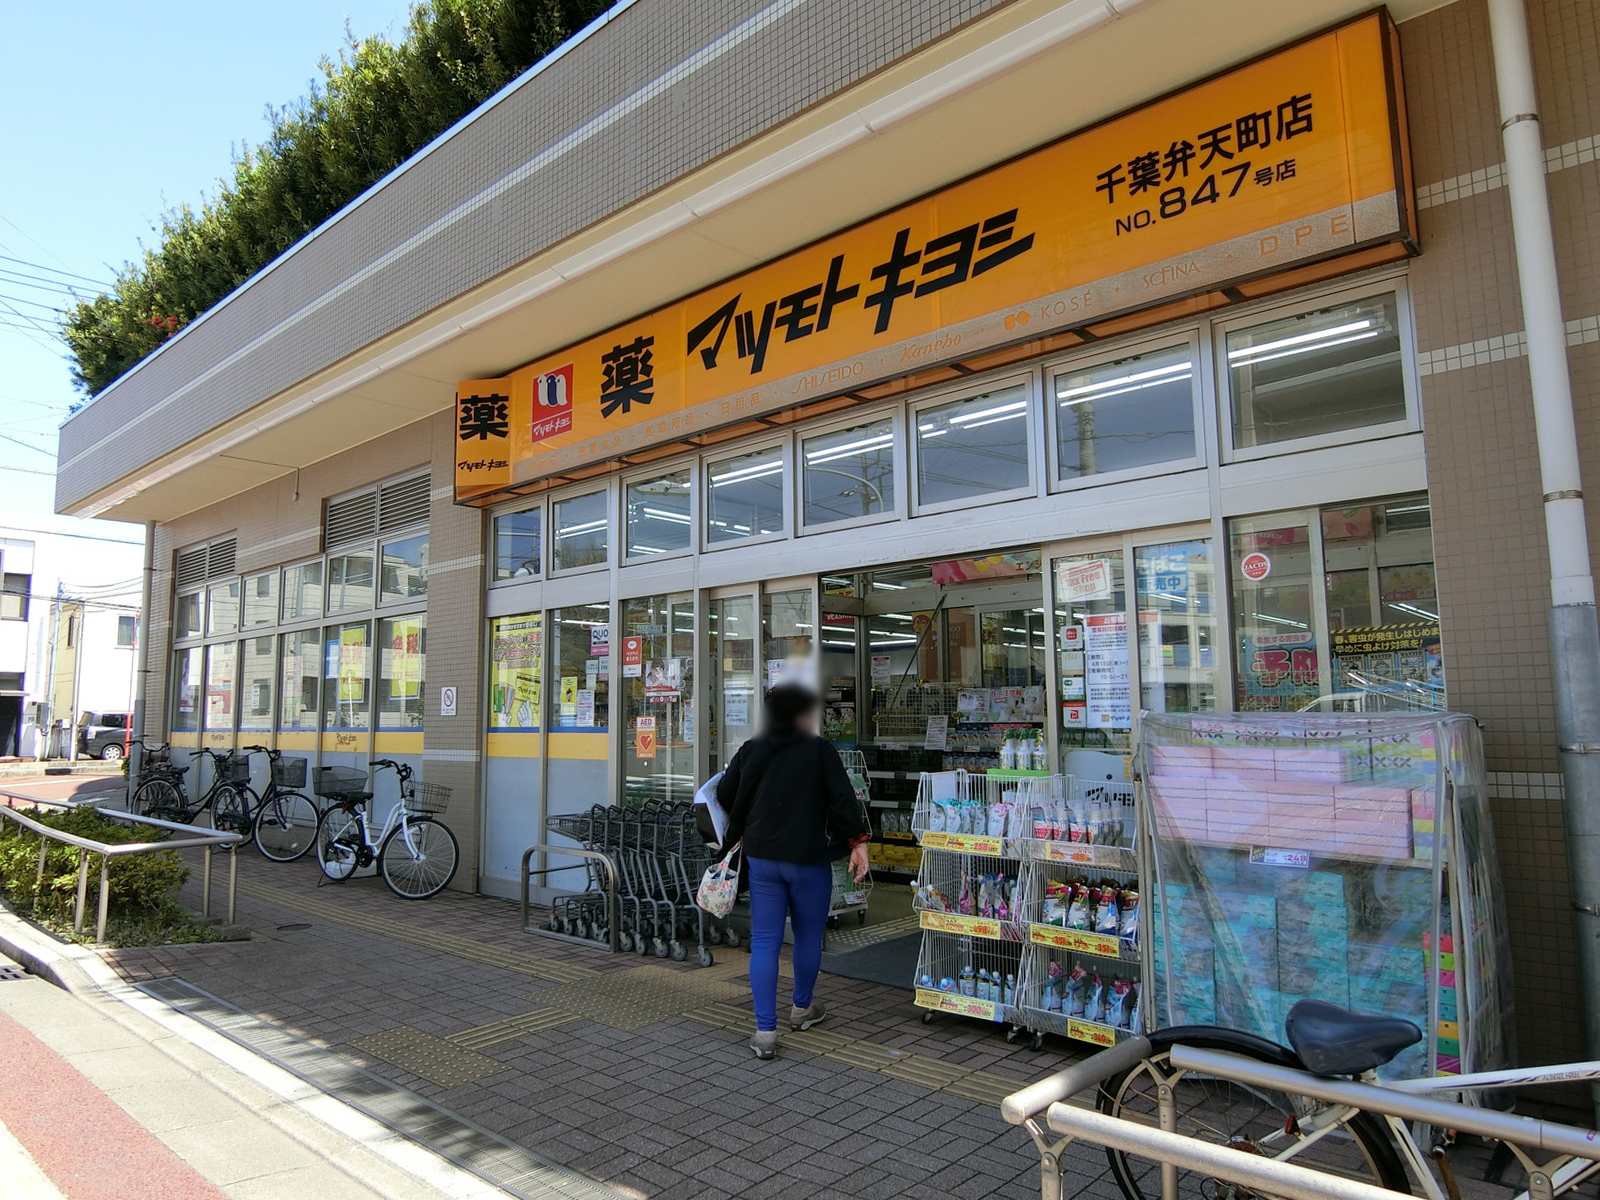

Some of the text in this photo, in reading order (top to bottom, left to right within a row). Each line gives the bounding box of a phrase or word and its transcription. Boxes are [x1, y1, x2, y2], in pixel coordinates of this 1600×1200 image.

[1095, 93, 1313, 203] 千葉弁天町店
[686, 207, 1036, 375] マツモトキヨシ
[791, 361, 864, 394] SHISEIDO
[900, 332, 962, 361] Kanebo
[1142, 261, 1200, 288] SOFINA
[601, 337, 654, 418] 薬
[459, 393, 510, 441] 薬
[533, 416, 572, 437] マツモトキヨシ
[457, 459, 510, 472] マツモトキヨシ
[1243, 561, 1268, 570] JACDS
[1065, 571, 1100, 588] Tax Free
[1073, 583, 1096, 596] Shop
[592, 628, 609, 640] QUO
[640, 718, 652, 726] AED
